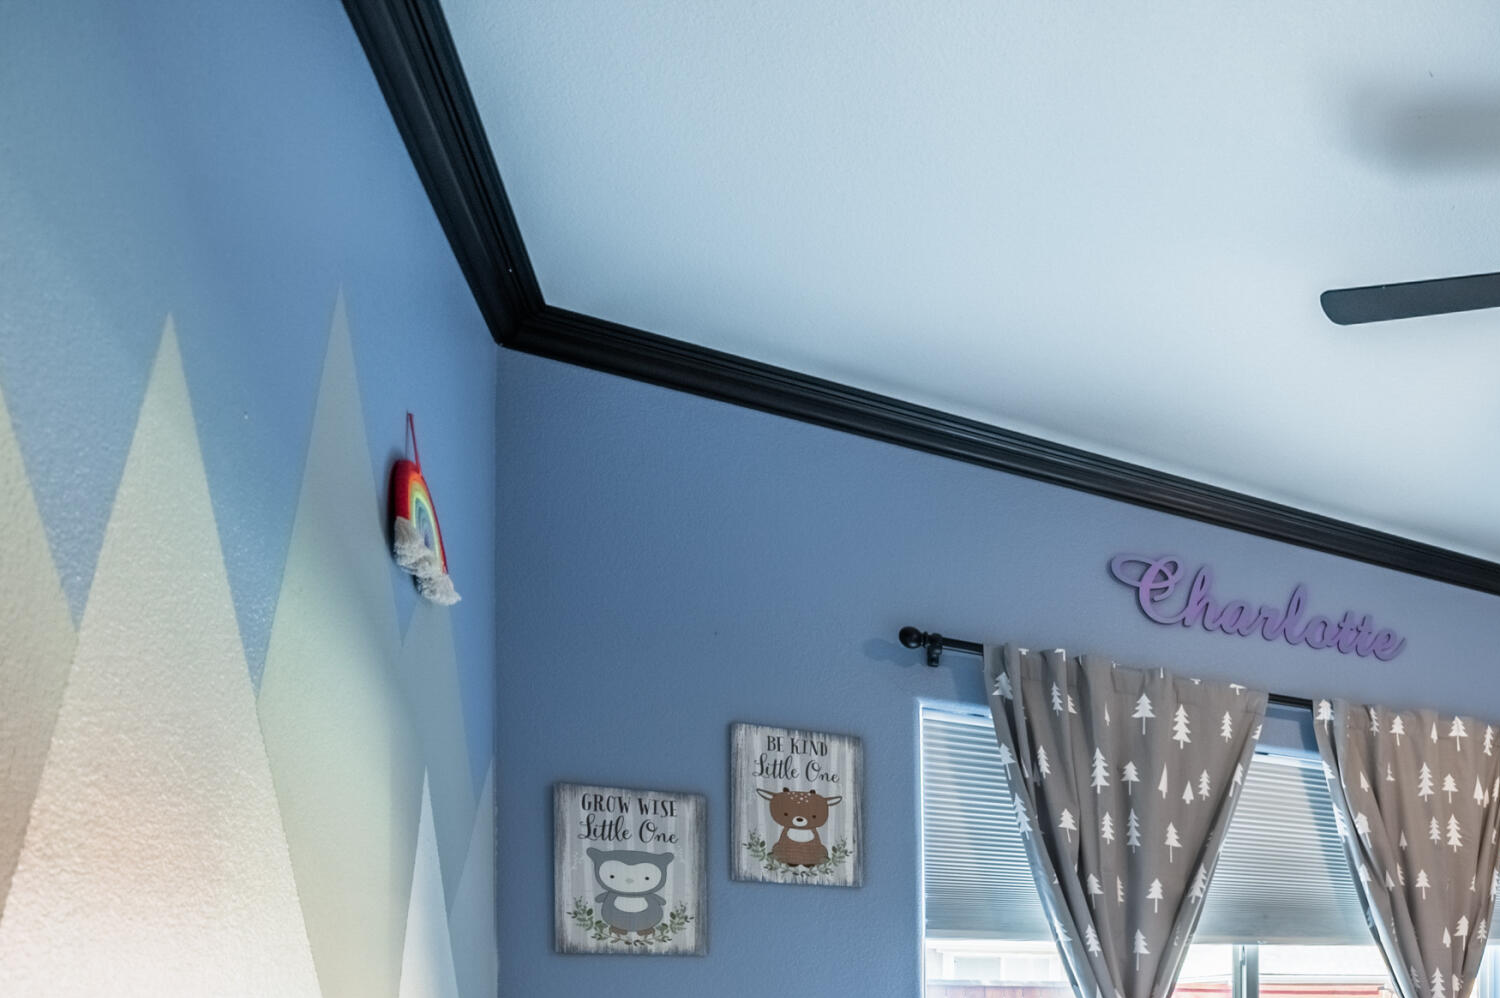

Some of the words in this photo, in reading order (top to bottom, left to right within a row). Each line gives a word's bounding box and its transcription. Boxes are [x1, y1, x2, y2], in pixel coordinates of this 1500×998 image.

[1107, 553, 1406, 662] Charlotte
[767, 735, 785, 752] BE
[790, 737, 828, 756] KIND
[752, 752, 800, 780] Little
[805, 760, 840, 783] One
[581, 792, 632, 814] GROW
[637, 797, 678, 818] WISE
[577, 813, 632, 842] Little
[639, 819, 679, 844] One
